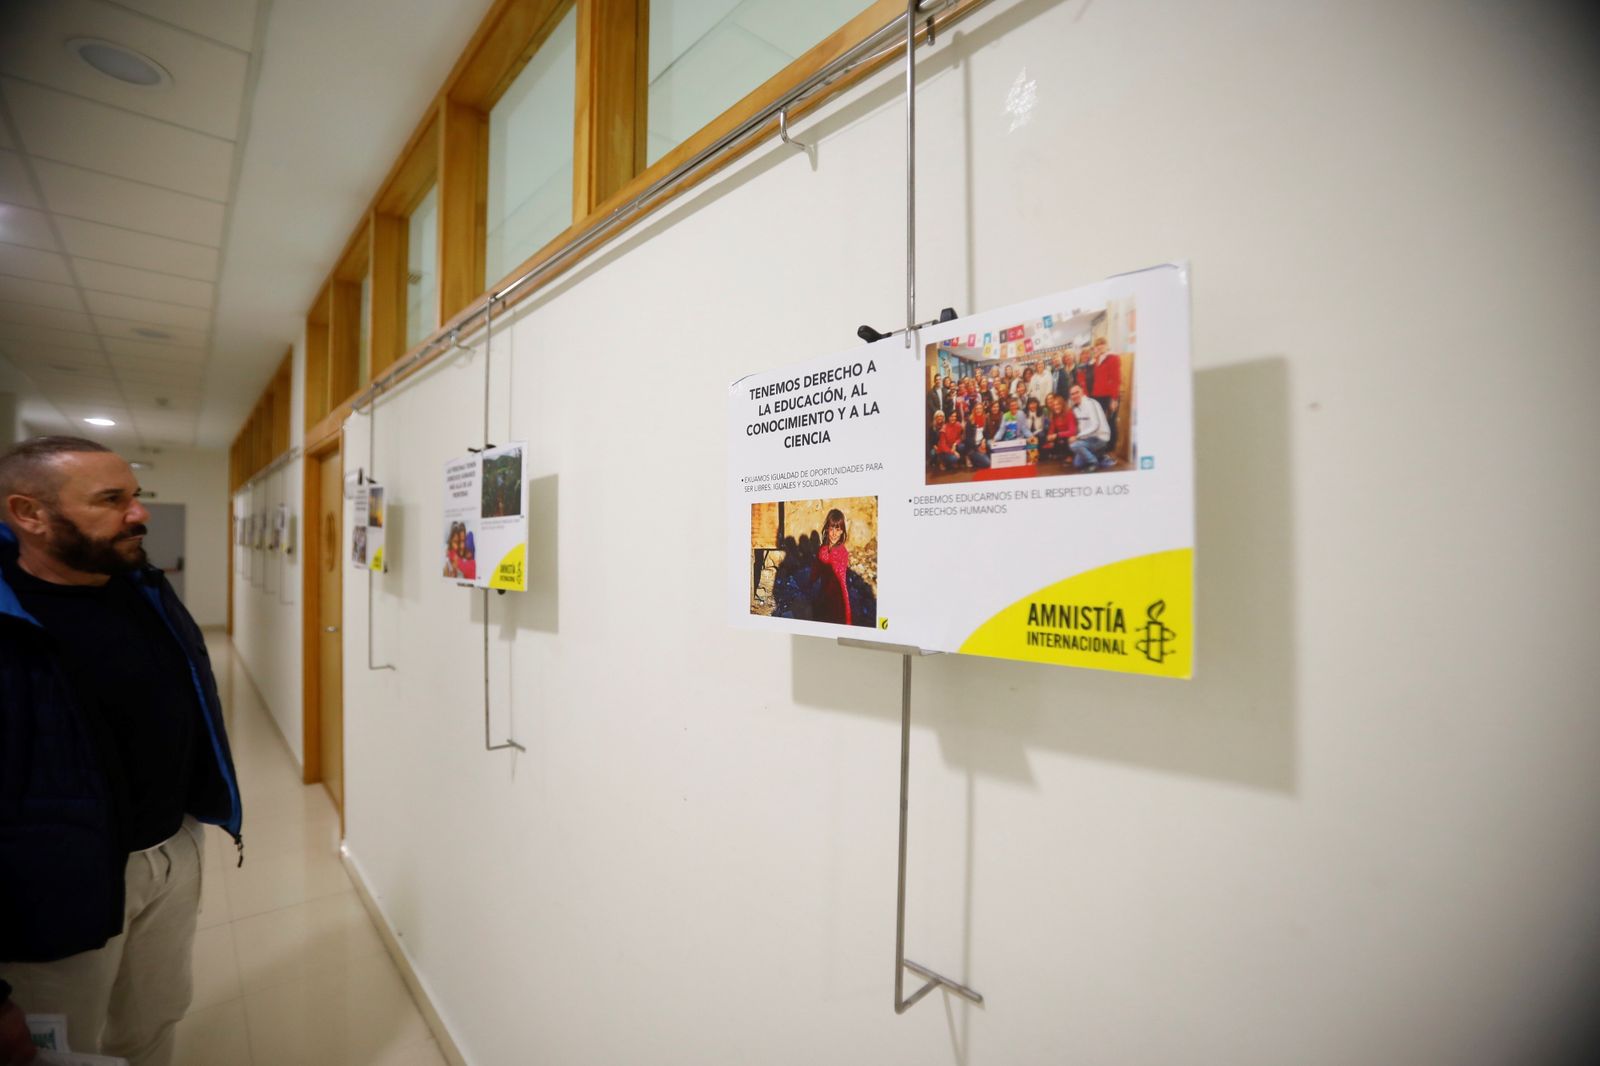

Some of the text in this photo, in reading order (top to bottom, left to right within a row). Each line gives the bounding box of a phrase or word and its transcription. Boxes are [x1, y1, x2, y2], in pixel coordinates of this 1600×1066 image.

[749, 360, 877, 400] TENEMOS DERECHO A
[758, 382, 868, 416] LA EDUCACIÓN, AL
[746, 401, 880, 436] CONOCIMIENTO Y A LA
[784, 430, 831, 448] CIENCIA
[770, 471, 799, 481] IGUALDAD
[800, 470, 809, 478] DE
[809, 464, 864, 477] OPORTUNIDADES
[865, 462, 883, 471] PARA
[744, 485, 754, 493] SER
[773, 481, 796, 490] IGUALES
[797, 480, 801, 489] Y
[802, 477, 839, 488] SOLIDARIOS
[913, 484, 1130, 505] DEBEMOS EDUCARNOS EN EL RESPETO A LOS
[913, 504, 1007, 517] DERECHOS HUMANOS
[1027, 601, 1126, 634] AMNISTÍA
[1027, 631, 1128, 656] INTERNACIONAL
